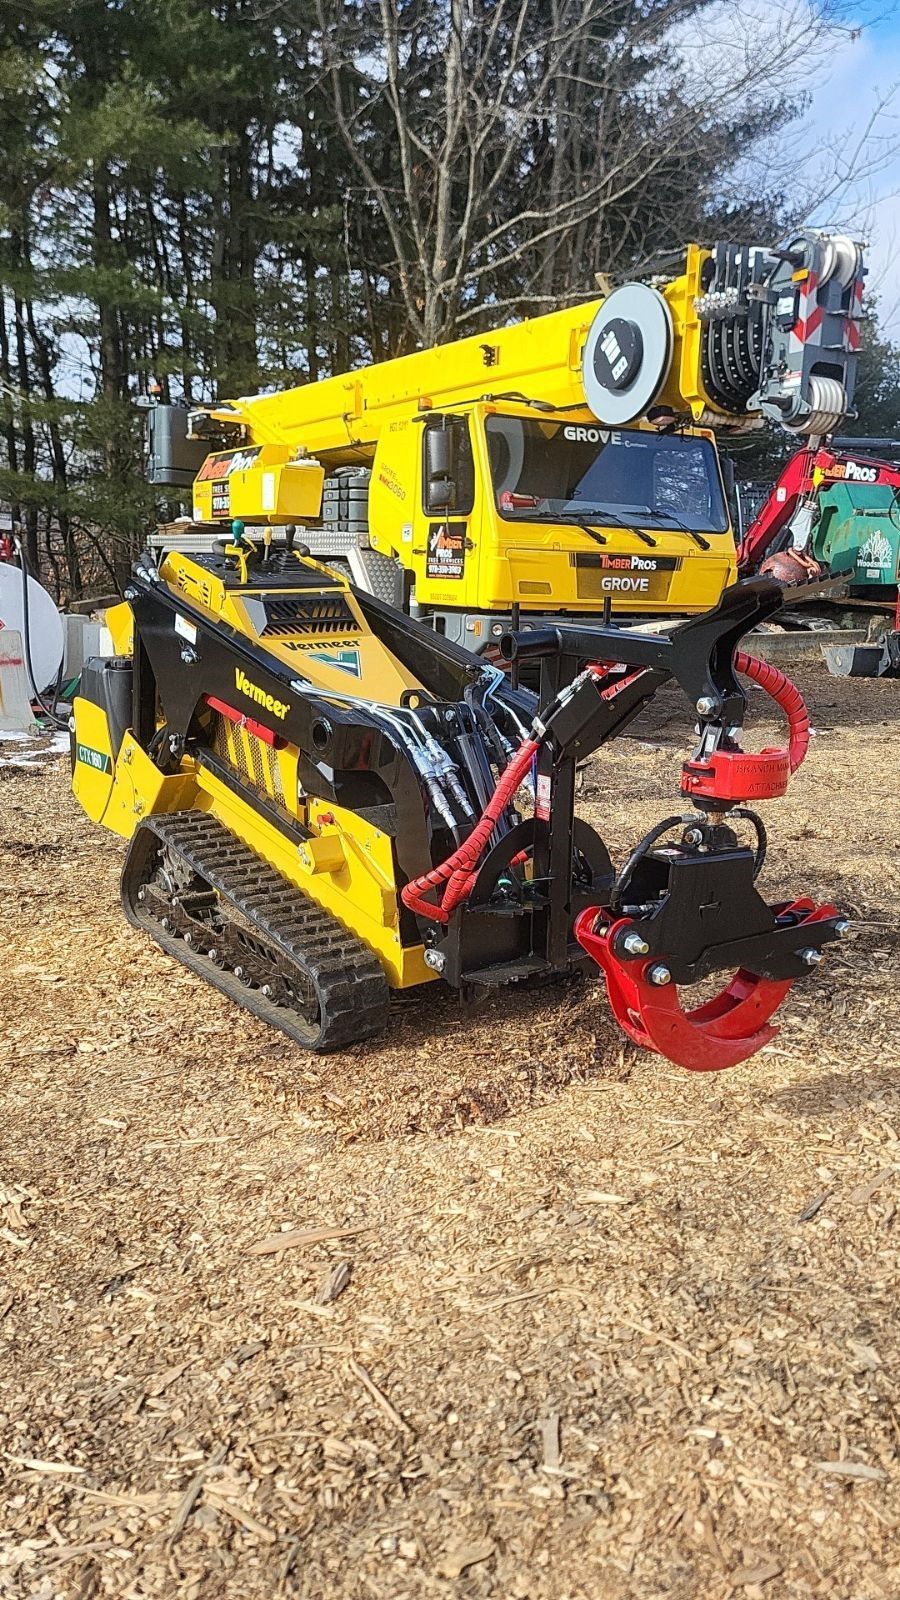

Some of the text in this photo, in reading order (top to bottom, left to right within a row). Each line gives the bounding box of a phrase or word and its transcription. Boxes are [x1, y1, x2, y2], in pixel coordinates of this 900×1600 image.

[563, 426, 622, 445] GROVE
[857, 559, 892, 569] Woodsman
[601, 577, 649, 592] GROVE
[281, 639, 361, 651] Vermeer
[235, 667, 290, 720] Vermeer
